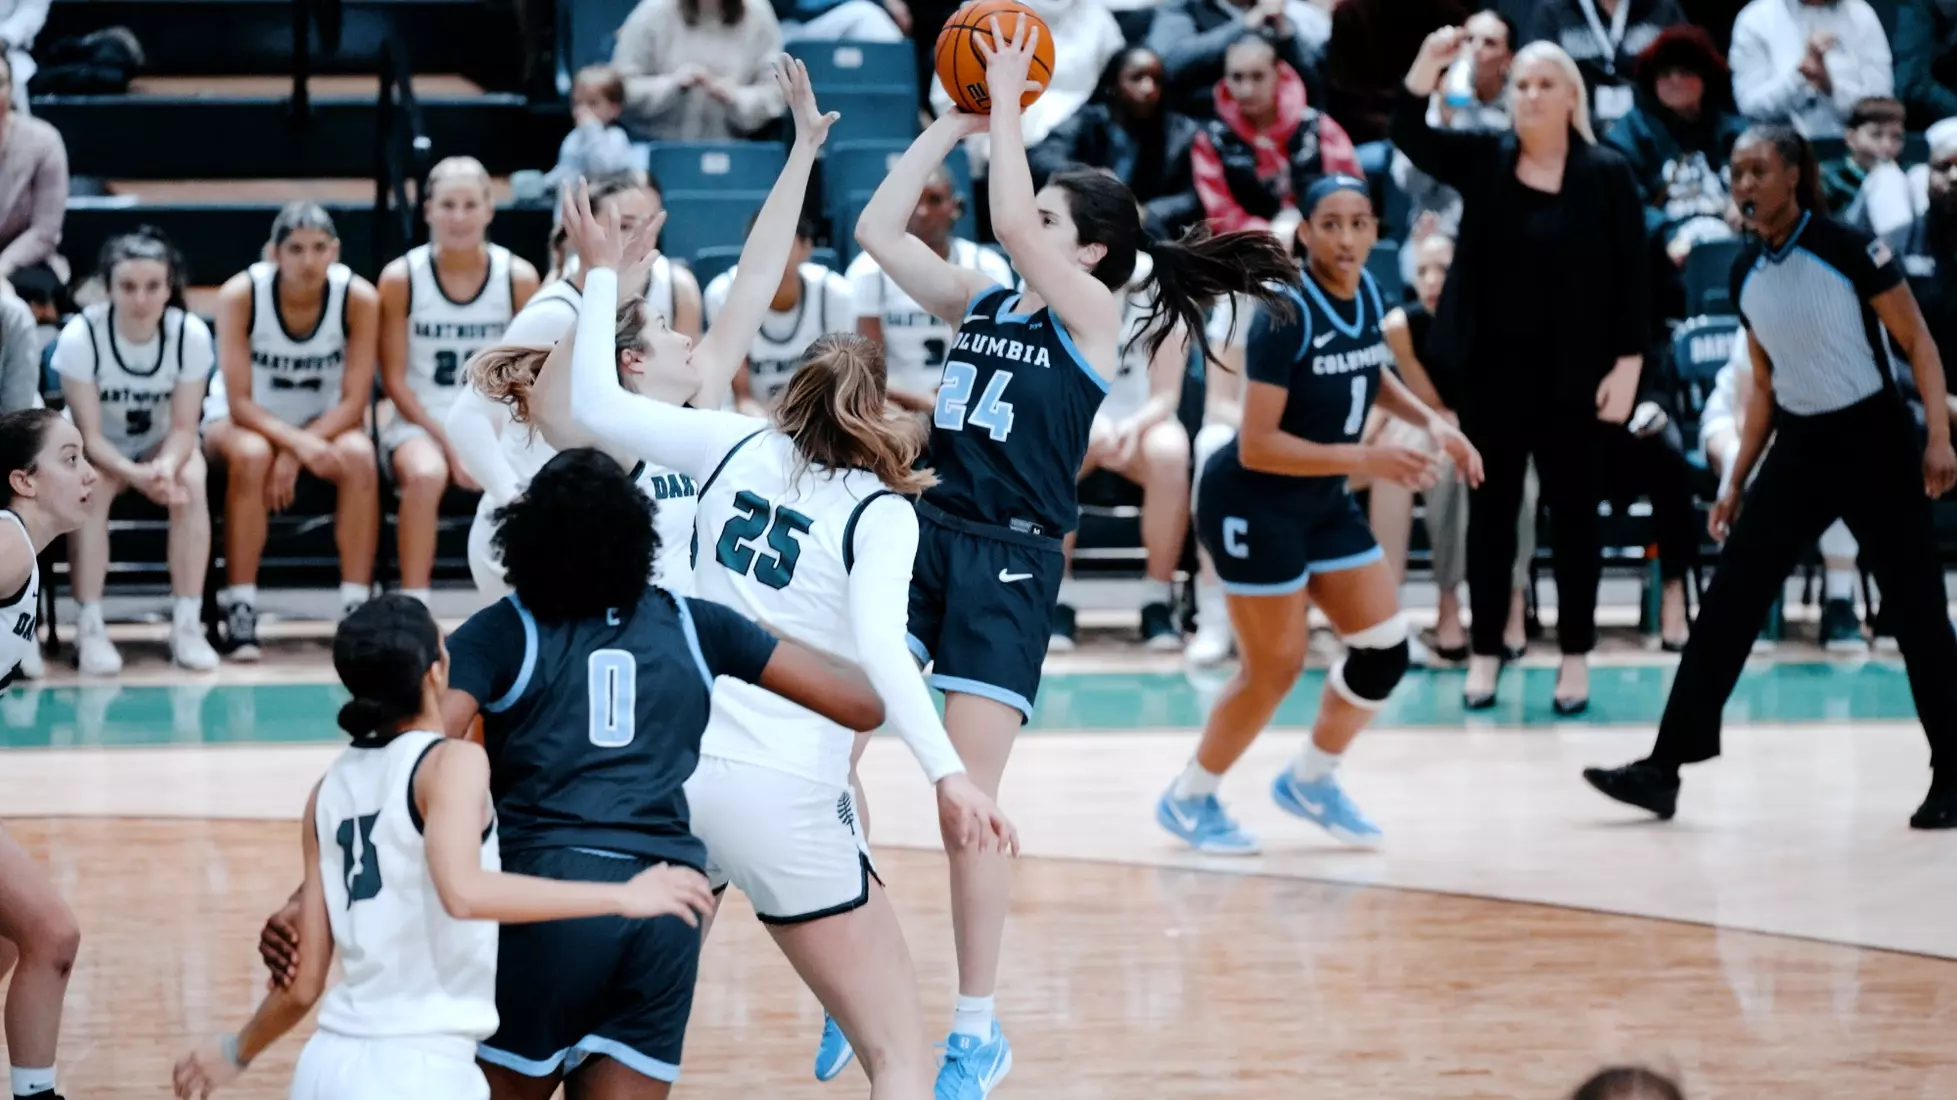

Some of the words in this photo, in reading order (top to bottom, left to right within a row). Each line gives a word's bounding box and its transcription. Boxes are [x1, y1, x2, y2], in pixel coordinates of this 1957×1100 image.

[934, 360, 1015, 442] 24
[1343, 375, 1367, 435] 1
[651, 473, 699, 500] DAR
[715, 490, 814, 590] 25
[1222, 515, 1249, 559] C
[588, 648, 637, 747] 0
